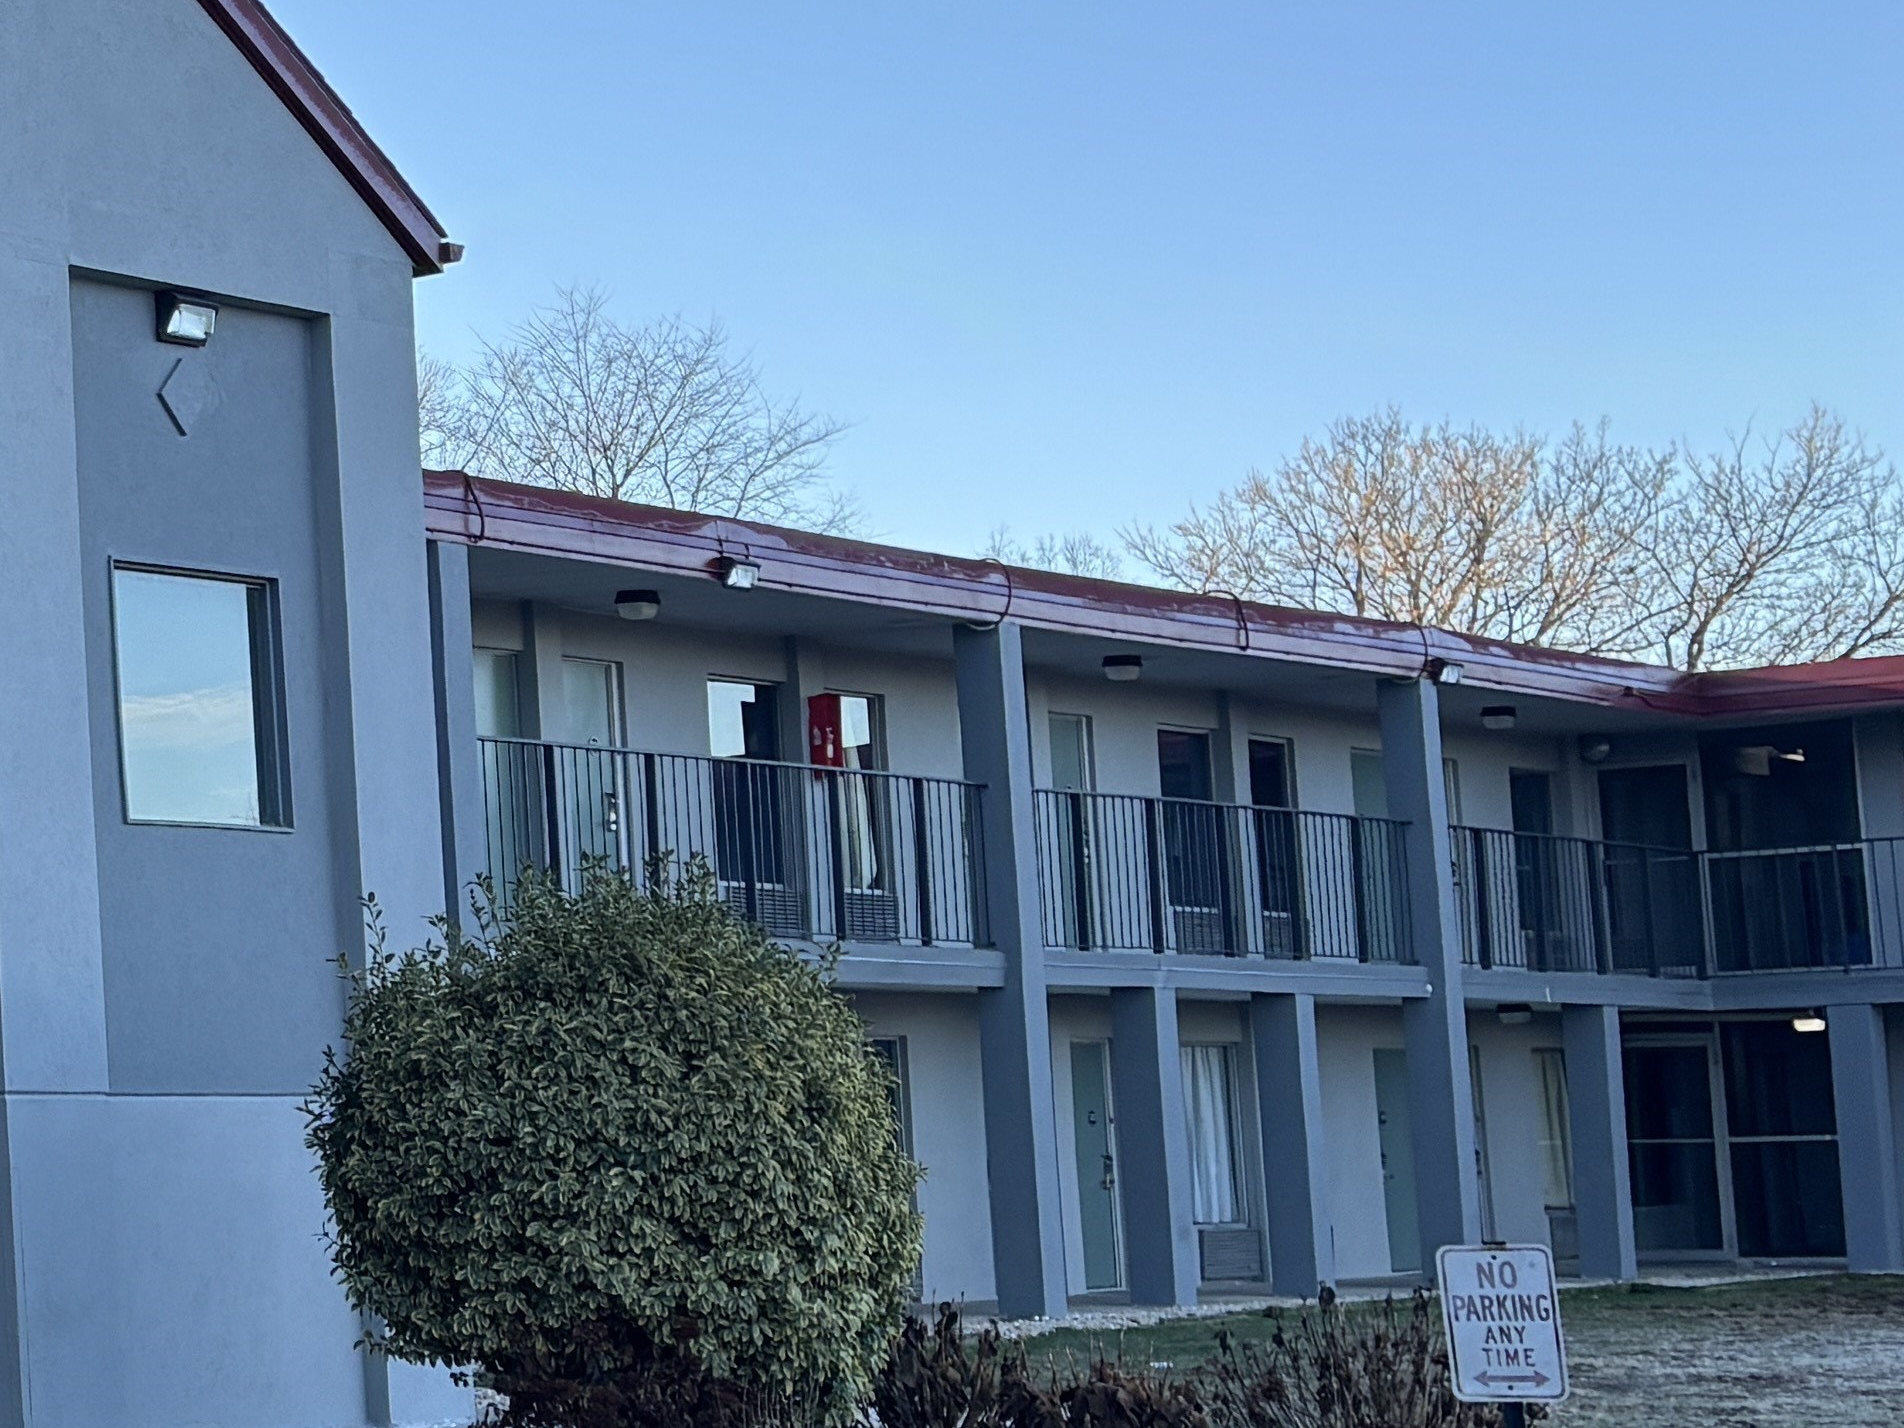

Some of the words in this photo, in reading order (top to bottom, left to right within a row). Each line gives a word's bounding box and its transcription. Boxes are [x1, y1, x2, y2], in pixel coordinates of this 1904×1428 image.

[1476, 1260, 1518, 1290] NO
[1451, 1294, 1551, 1323] PARKING
[1484, 1325, 1527, 1345] ANY
[1481, 1347, 1536, 1368] TIME
